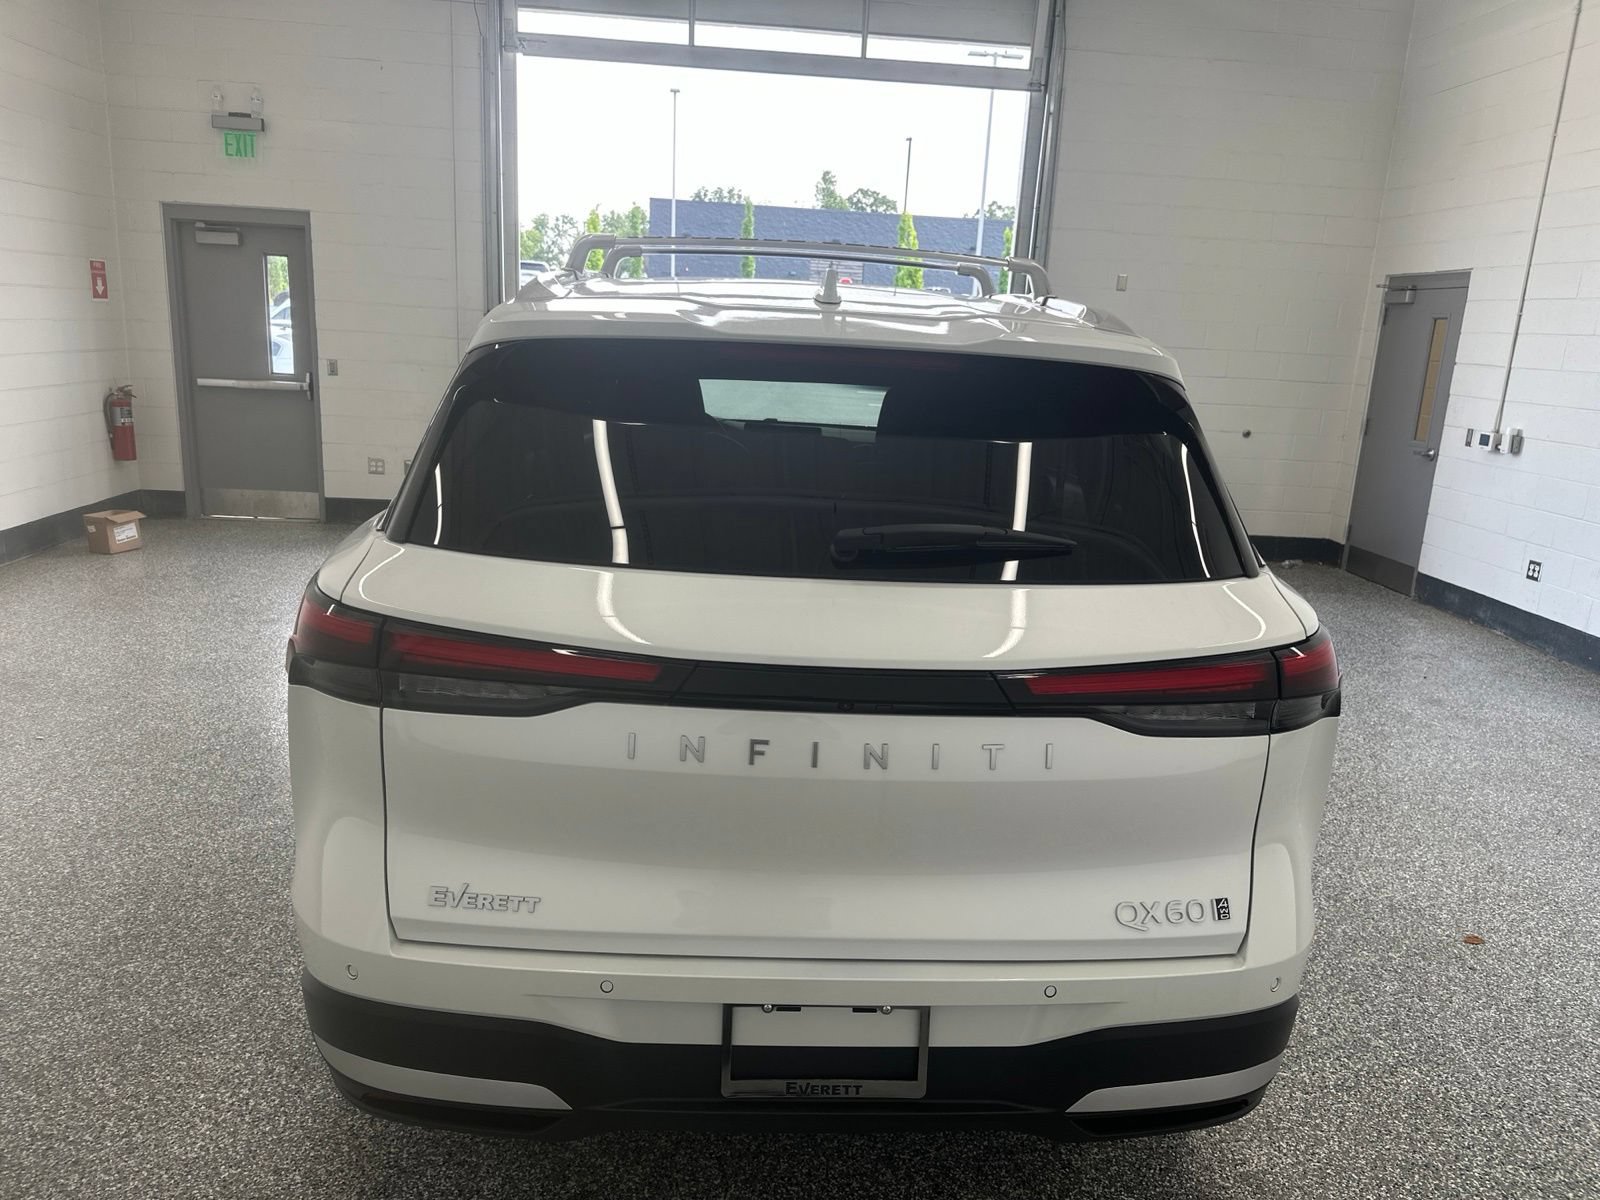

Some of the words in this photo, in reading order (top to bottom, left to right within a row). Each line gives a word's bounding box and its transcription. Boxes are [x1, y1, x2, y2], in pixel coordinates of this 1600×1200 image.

[224, 132, 256, 157] EXIT
[627, 732, 1054, 770] INFINITI
[428, 883, 541, 913] EVERETT
[1115, 899, 1205, 932] QX60
[786, 1082, 863, 1096] EVERETT
